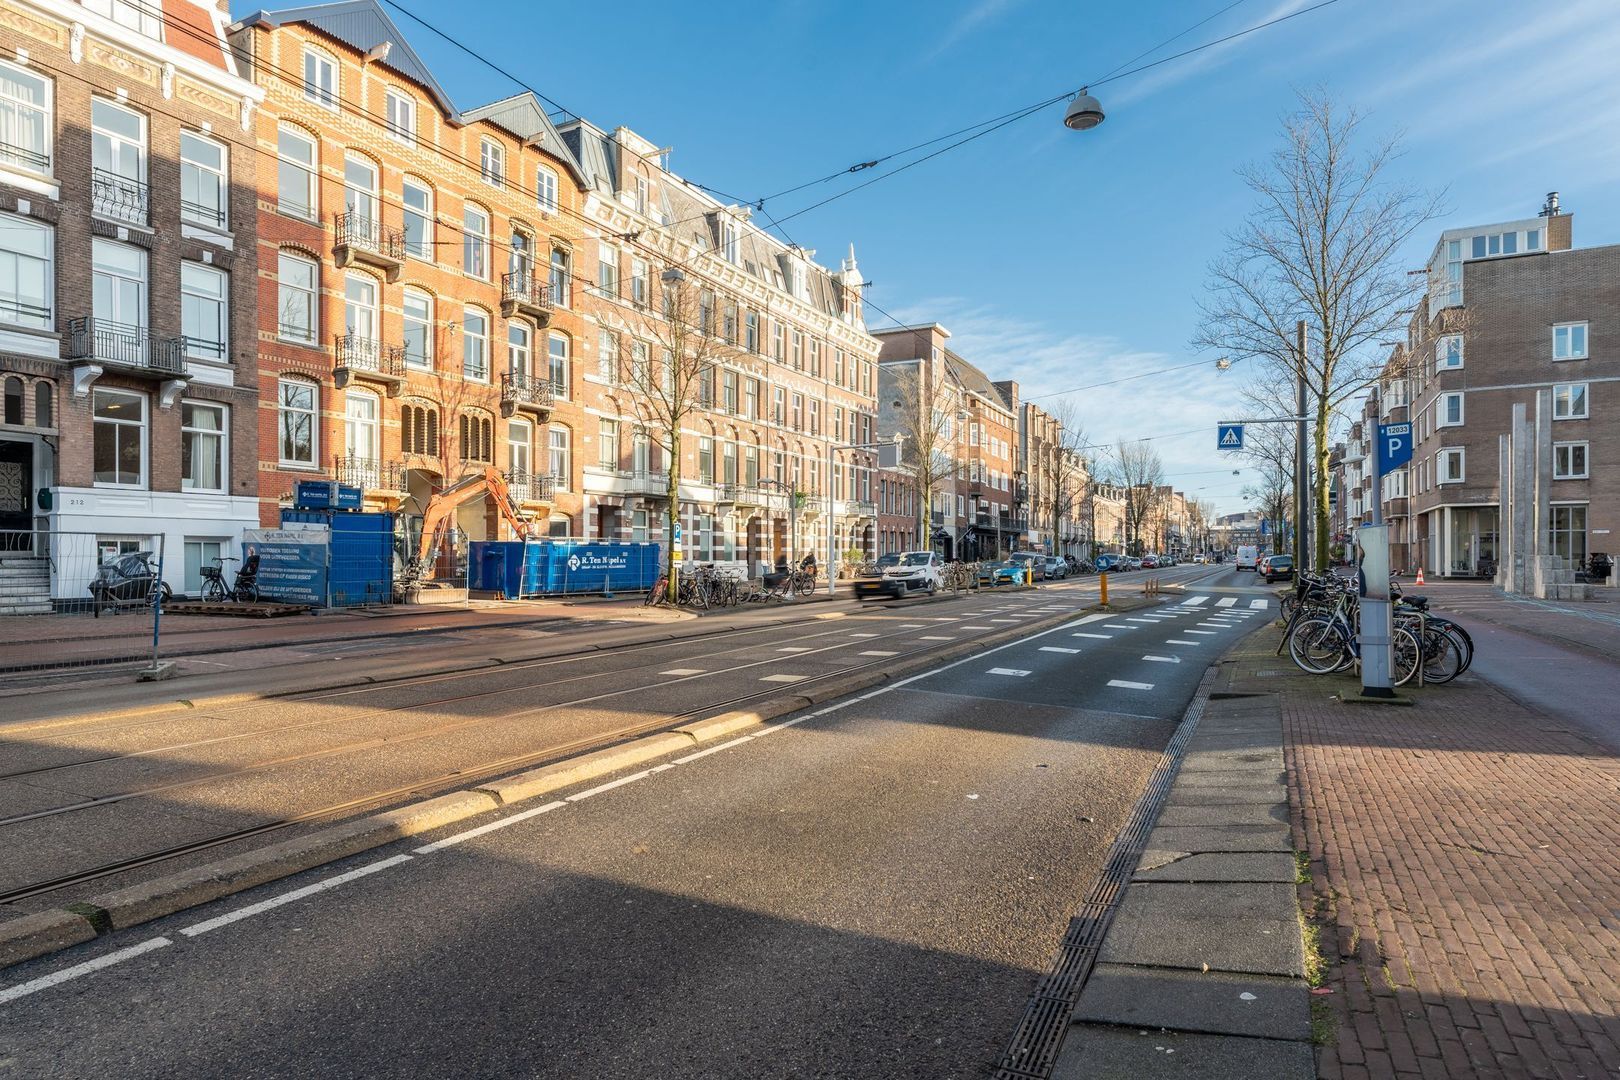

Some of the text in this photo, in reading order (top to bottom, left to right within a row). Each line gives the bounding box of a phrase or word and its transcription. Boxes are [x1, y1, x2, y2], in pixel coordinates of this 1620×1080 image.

[1388, 426, 1408, 434] 12033
[1389, 438, 1402, 458] P
[675, 525, 680, 537] P
[590, 556, 601, 564] Ten
